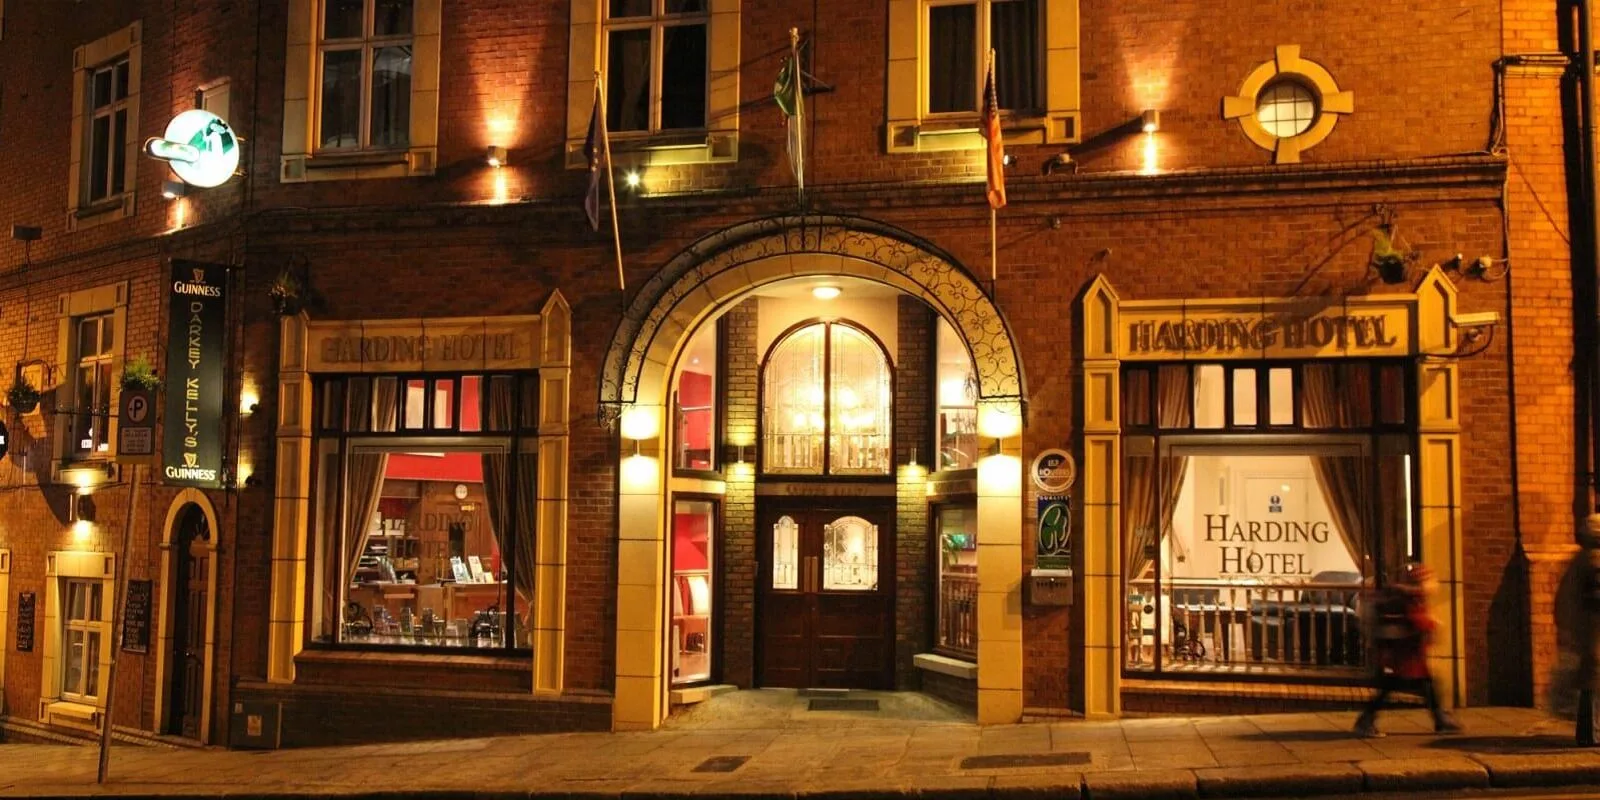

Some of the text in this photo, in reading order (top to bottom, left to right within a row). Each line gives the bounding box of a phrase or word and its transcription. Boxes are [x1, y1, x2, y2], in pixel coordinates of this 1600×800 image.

[174, 281, 221, 296] GUINNESS
[188, 302, 203, 369] DARKEY
[440, 333, 520, 361] HOTEL
[1129, 314, 1397, 352] HARDING HOTEL
[185, 377, 199, 448] KELLY'S
[165, 466, 217, 480] GUINNESS
[1203, 514, 1329, 543] HARDING
[1218, 546, 1312, 575] HOTEL
